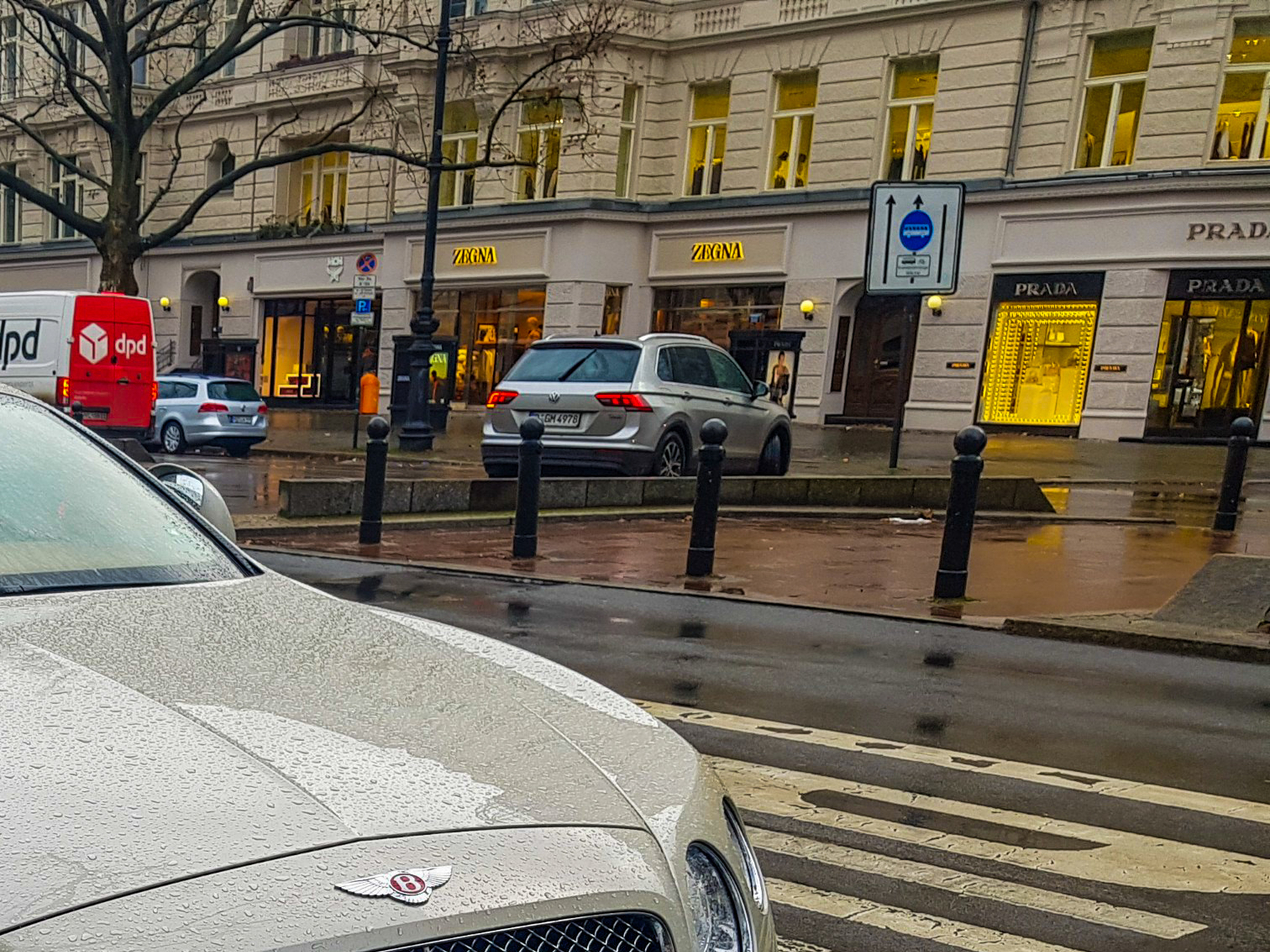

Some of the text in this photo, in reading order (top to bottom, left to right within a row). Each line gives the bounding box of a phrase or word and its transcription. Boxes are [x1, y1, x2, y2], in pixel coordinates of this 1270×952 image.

[1186, 222, 1270, 241] PRAD
[452, 246, 497, 266] ZEGNA
[691, 241, 744, 262] ZEGNA
[1014, 282, 1077, 296] PRADA
[1186, 278, 1265, 293] PRADA
[115, 333, 147, 360] dpd
[557, 414, 578, 424] 4978
